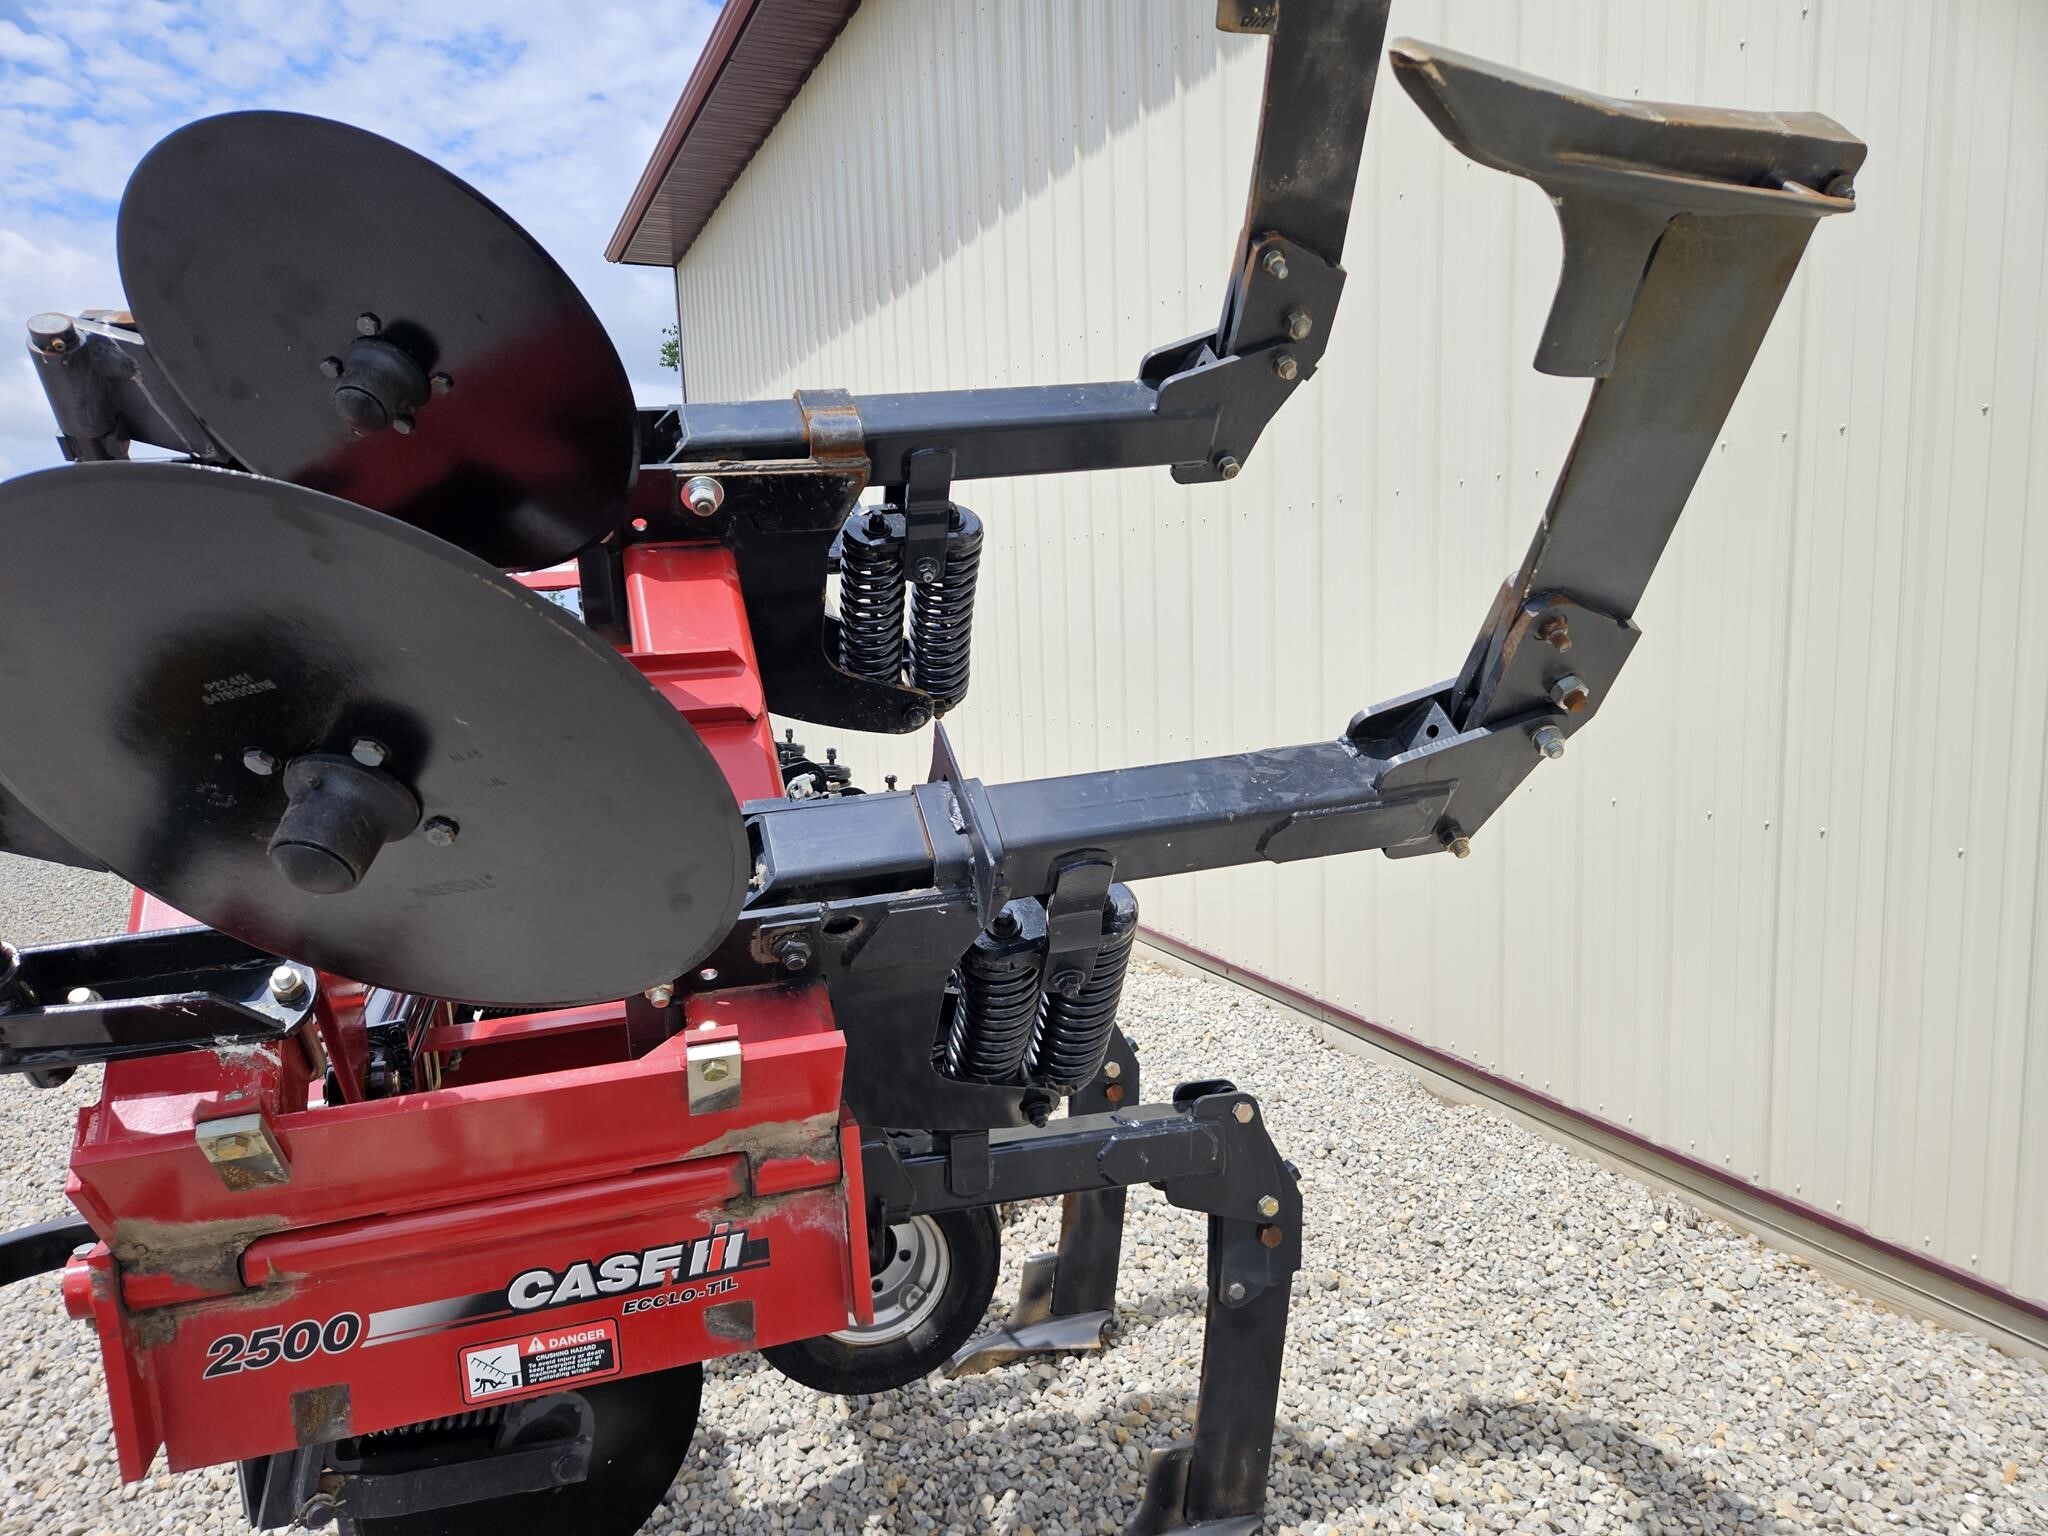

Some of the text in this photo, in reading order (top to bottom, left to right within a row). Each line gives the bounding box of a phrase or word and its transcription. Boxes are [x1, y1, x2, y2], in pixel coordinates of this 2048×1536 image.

[507, 1244, 684, 1310] CASE
[203, 1311, 362, 1380] 2500
[549, 1329, 605, 1349] DANGER
[535, 1344, 597, 1362] CRUSHING HAZARD
[538, 1359, 556, 1367] avoid
[586, 1349, 605, 1357] death
[528, 1366, 545, 1375] keep
[546, 1361, 576, 1371] everyone
[529, 1359, 600, 1379] machine when folding
[538, 1371, 570, 1382] unfolding
